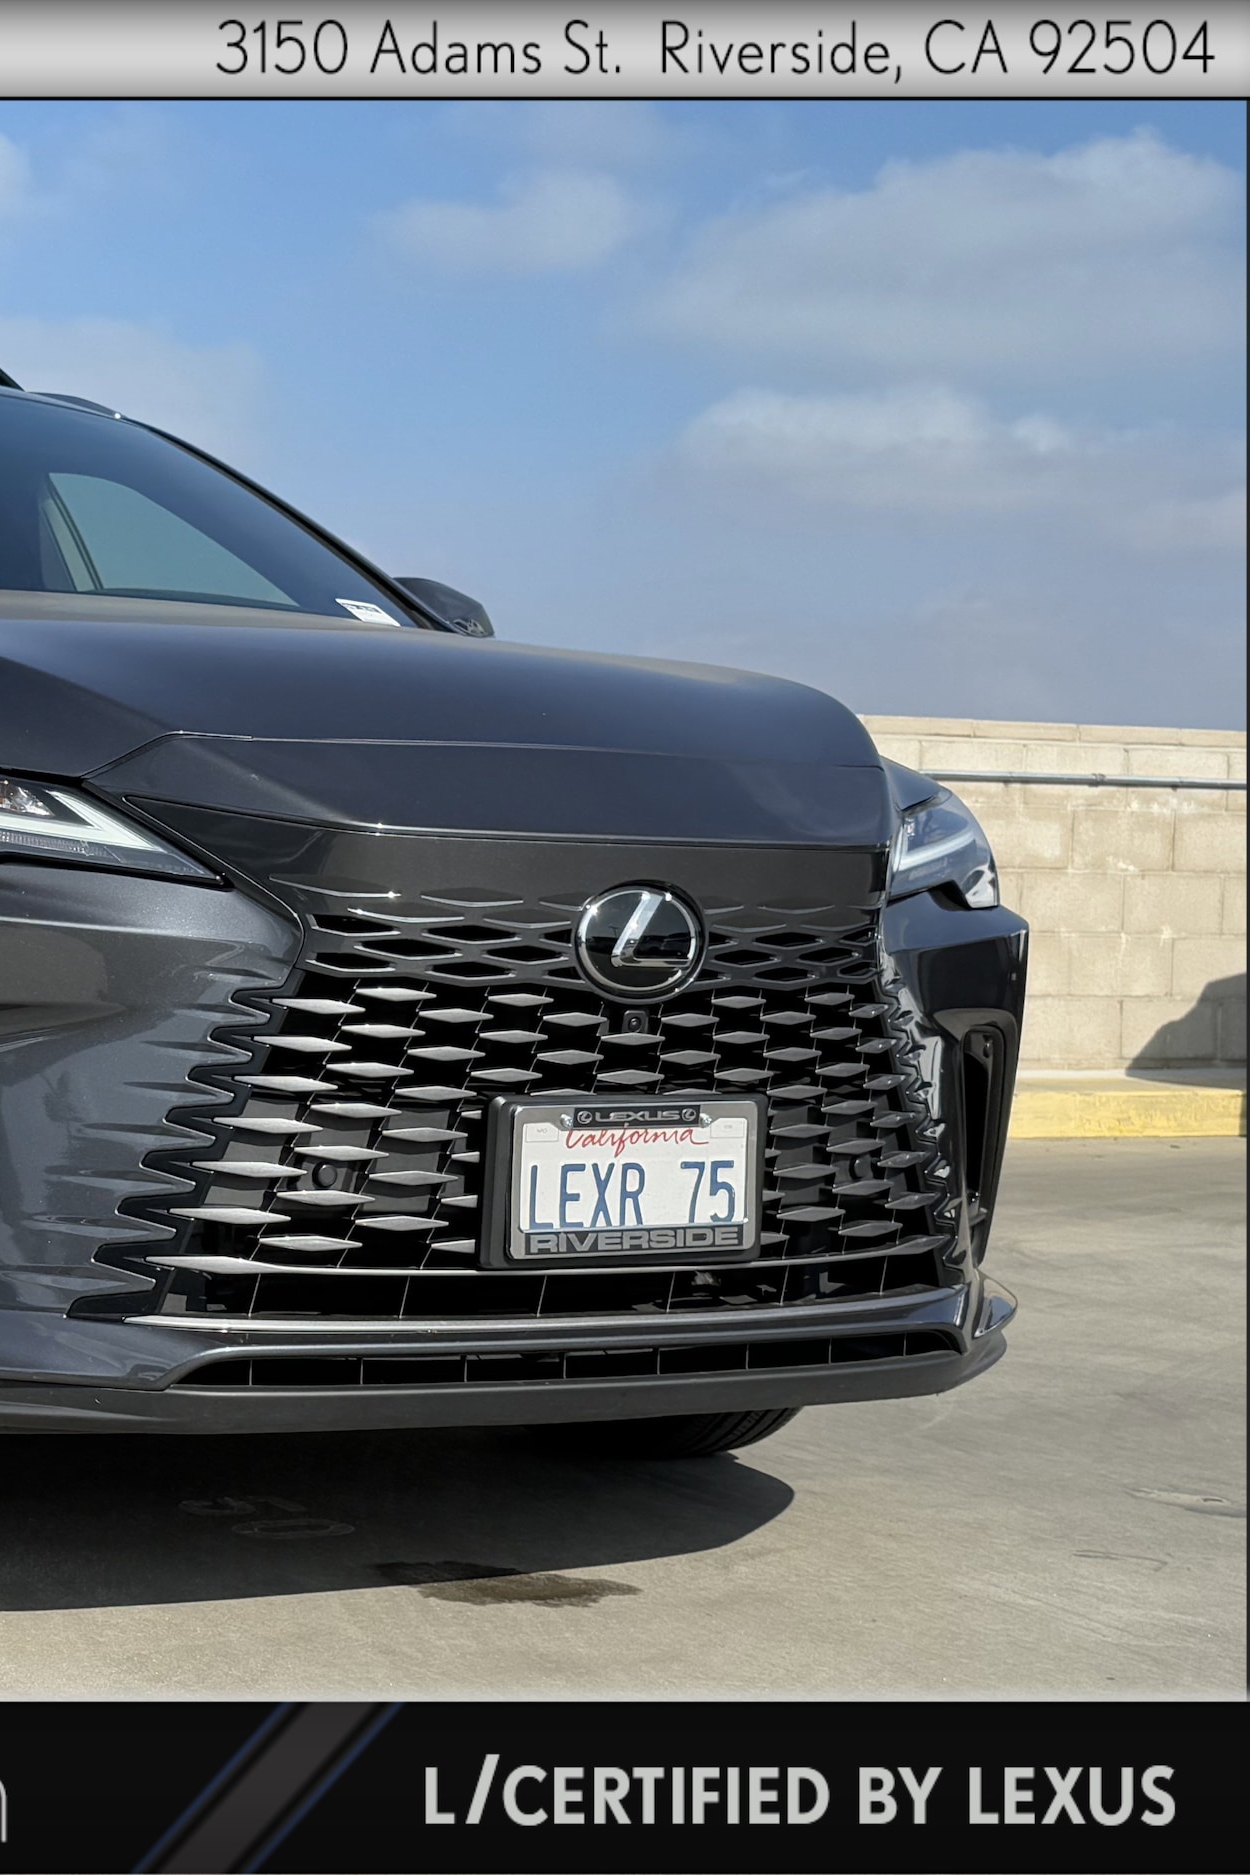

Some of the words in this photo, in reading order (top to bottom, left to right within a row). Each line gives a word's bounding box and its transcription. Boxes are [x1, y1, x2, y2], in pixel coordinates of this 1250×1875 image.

[594, 1109, 681, 1122] LEXUS
[565, 1127, 710, 1158] California
[529, 1161, 646, 1230] LEXR
[680, 1160, 735, 1224] 75
[529, 1227, 739, 1254] RIVERSIDE
